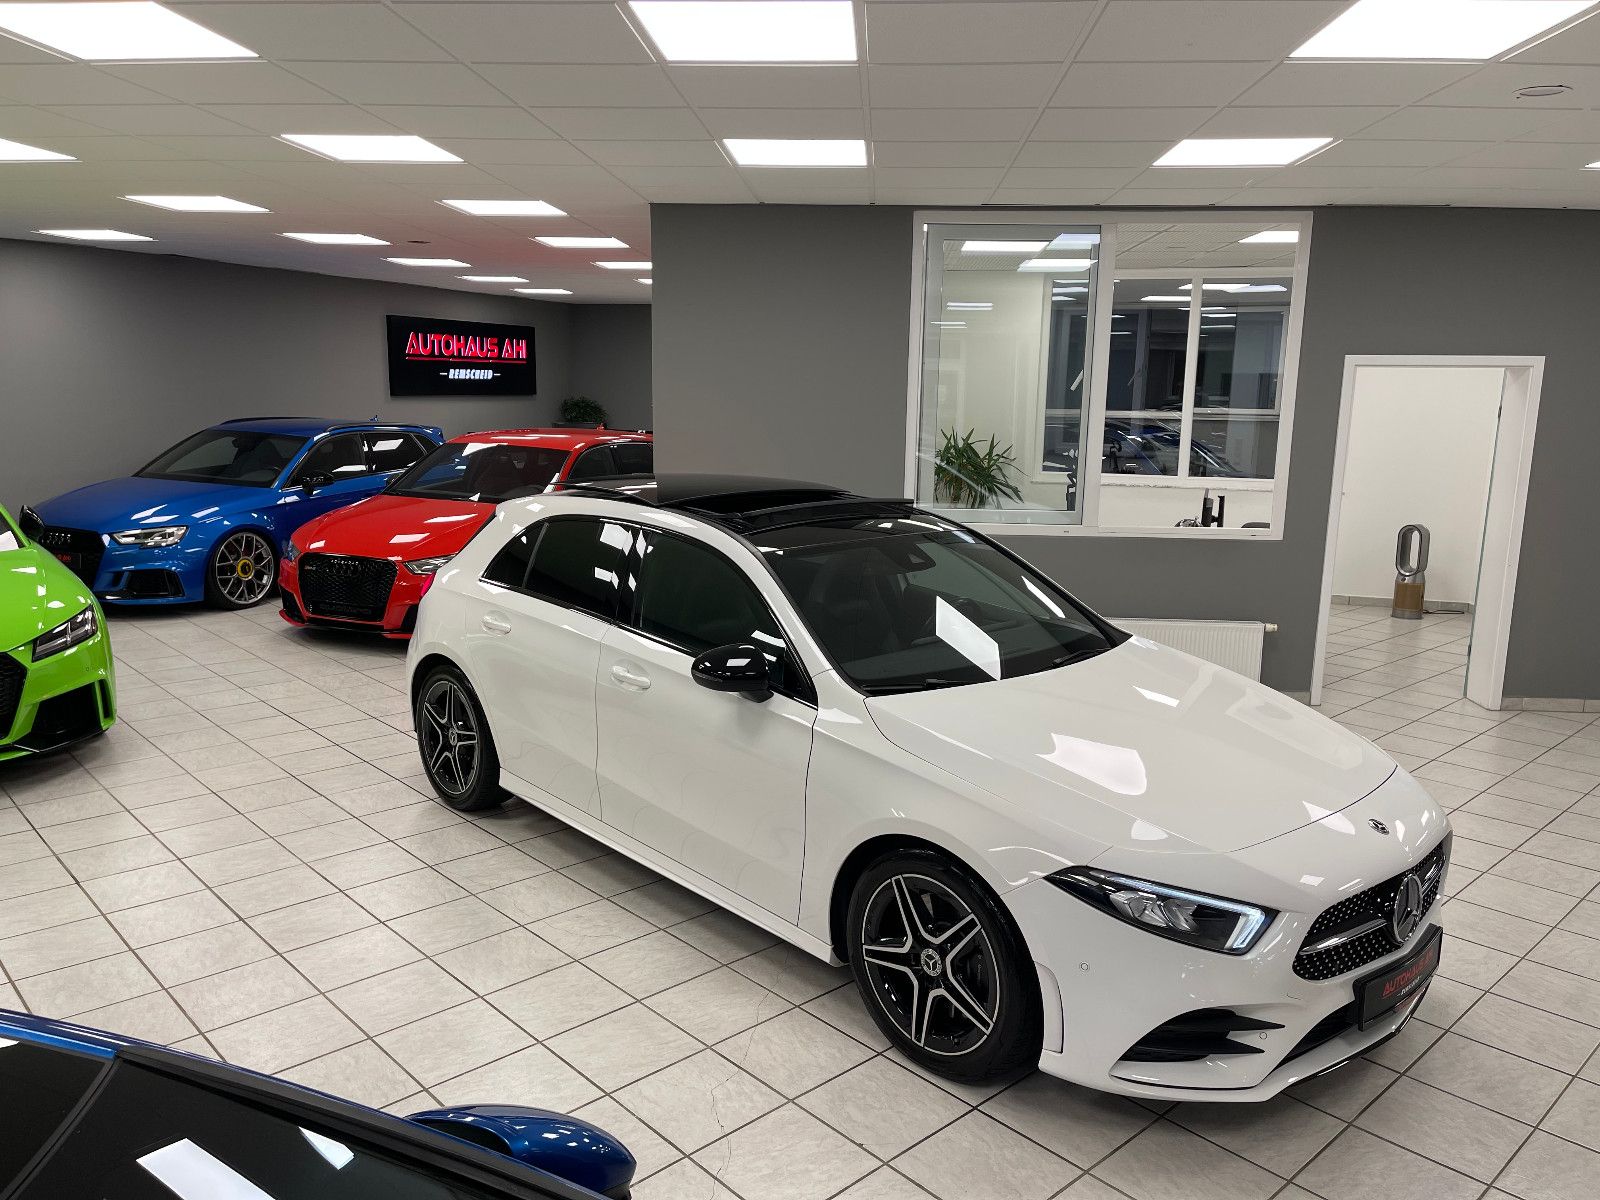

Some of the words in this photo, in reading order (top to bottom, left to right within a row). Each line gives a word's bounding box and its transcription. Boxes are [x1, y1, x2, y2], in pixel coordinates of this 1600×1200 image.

[405, 331, 499, 358] AUTOHAUS
[501, 338, 527, 359] AH
[448, 368, 493, 380] REMSCHEID
